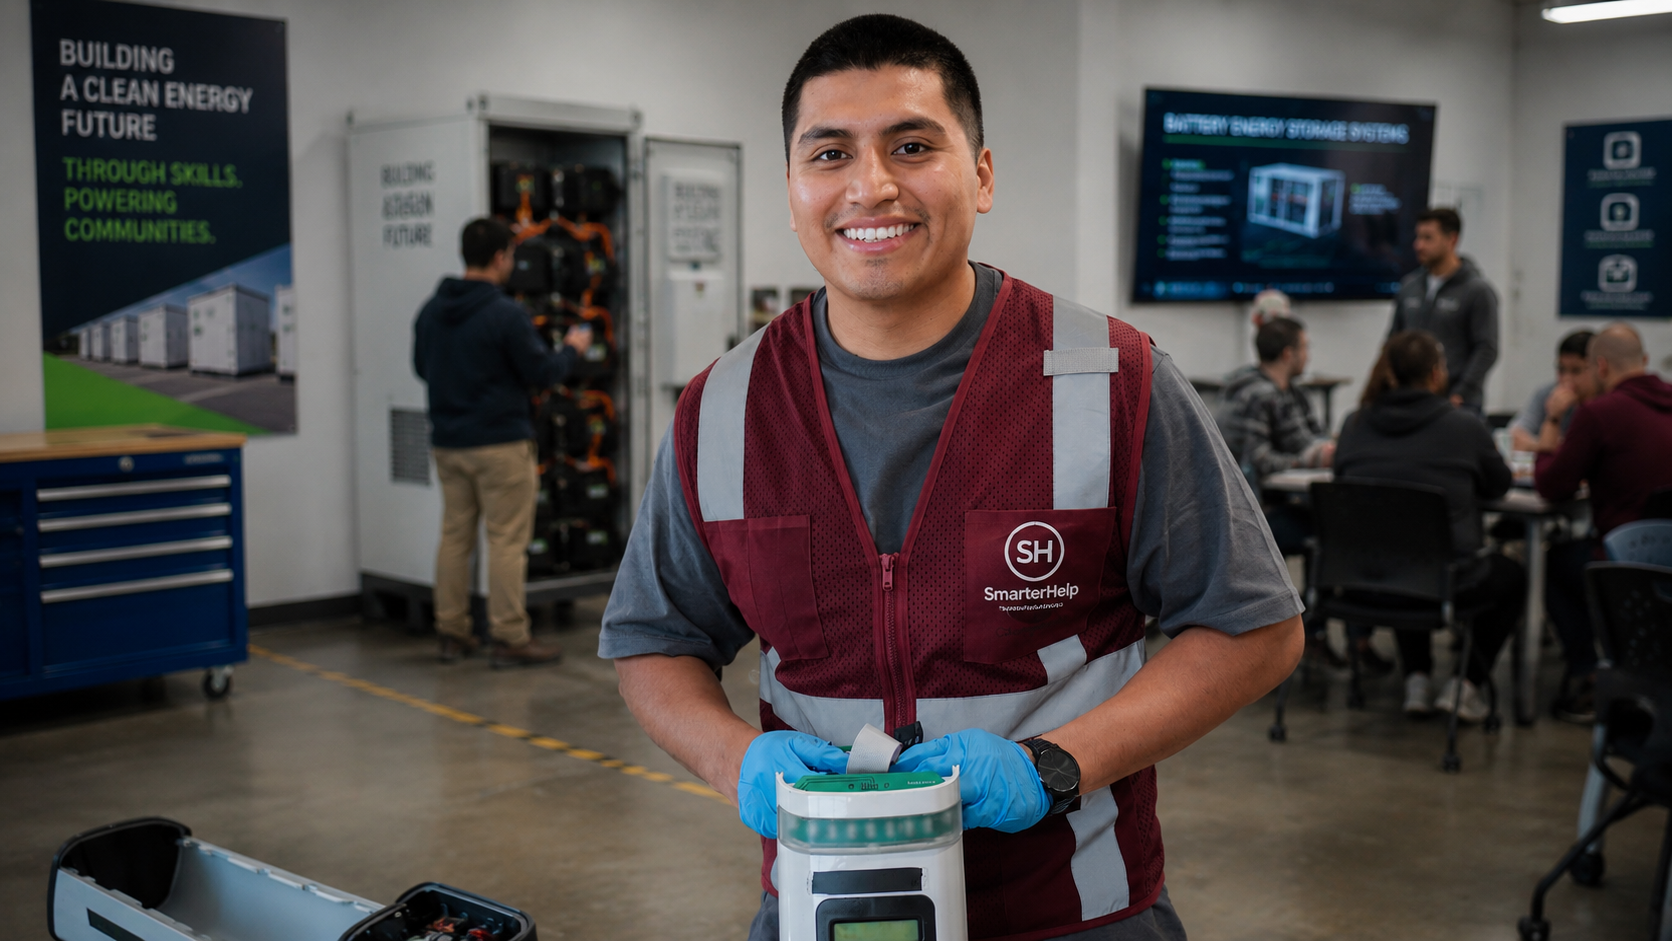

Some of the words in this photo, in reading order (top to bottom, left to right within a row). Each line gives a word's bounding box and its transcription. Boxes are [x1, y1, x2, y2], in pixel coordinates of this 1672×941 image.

[59, 39, 175, 75] BUILDING
[60, 74, 78, 102] A
[83, 76, 159, 107] CLEAN
[164, 82, 253, 114] ENERGY
[61, 109, 158, 142] FUTURE
[1163, 112, 1228, 136] BATTERY
[1230, 115, 1285, 139] ENERGY
[1286, 118, 1348, 142] STORAGE
[1348, 121, 1410, 145] SYSTEMS
[62, 157, 166, 185] THROUGH
[169, 161, 243, 188] SKILLS.
[64, 187, 177, 214] POWERING
[64, 216, 216, 244] COMMUNITIES.
[1016, 539, 1053, 564] SH
[983, 582, 1079, 602] SmarterHelp
